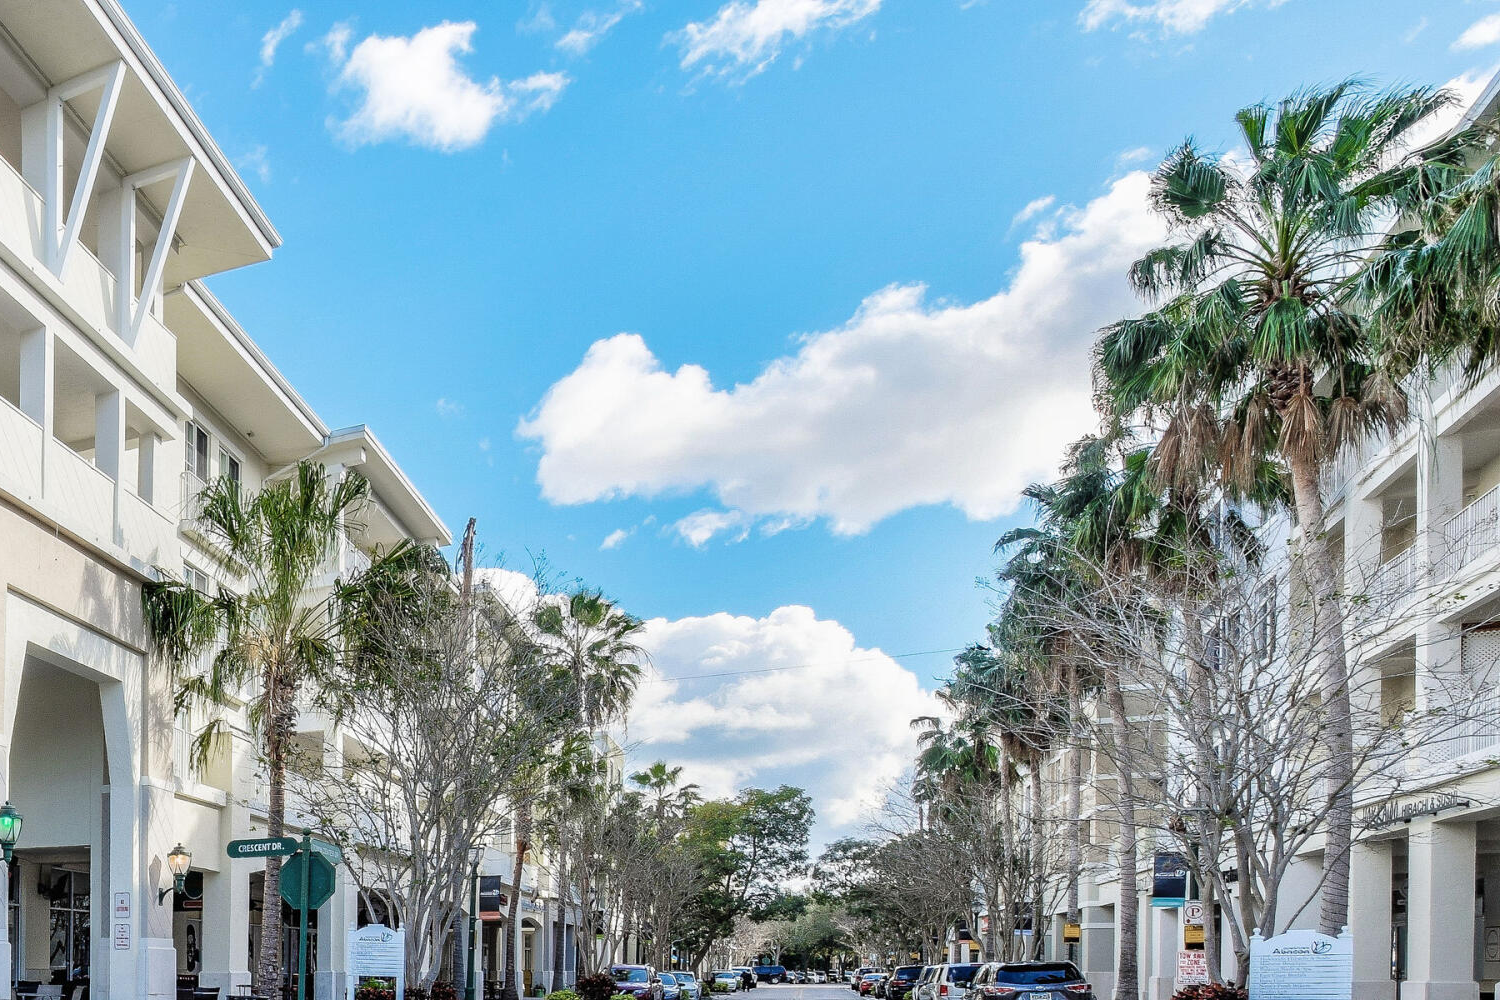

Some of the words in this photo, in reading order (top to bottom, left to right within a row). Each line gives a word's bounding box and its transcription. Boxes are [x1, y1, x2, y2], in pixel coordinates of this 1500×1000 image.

[1401, 798, 1429, 816] HIBACHI
[1436, 790, 1459, 806] SUSHI
[238, 842, 271, 853] CRESCENT
[271, 842, 285, 851] DR.
[1191, 907, 1200, 917] P
